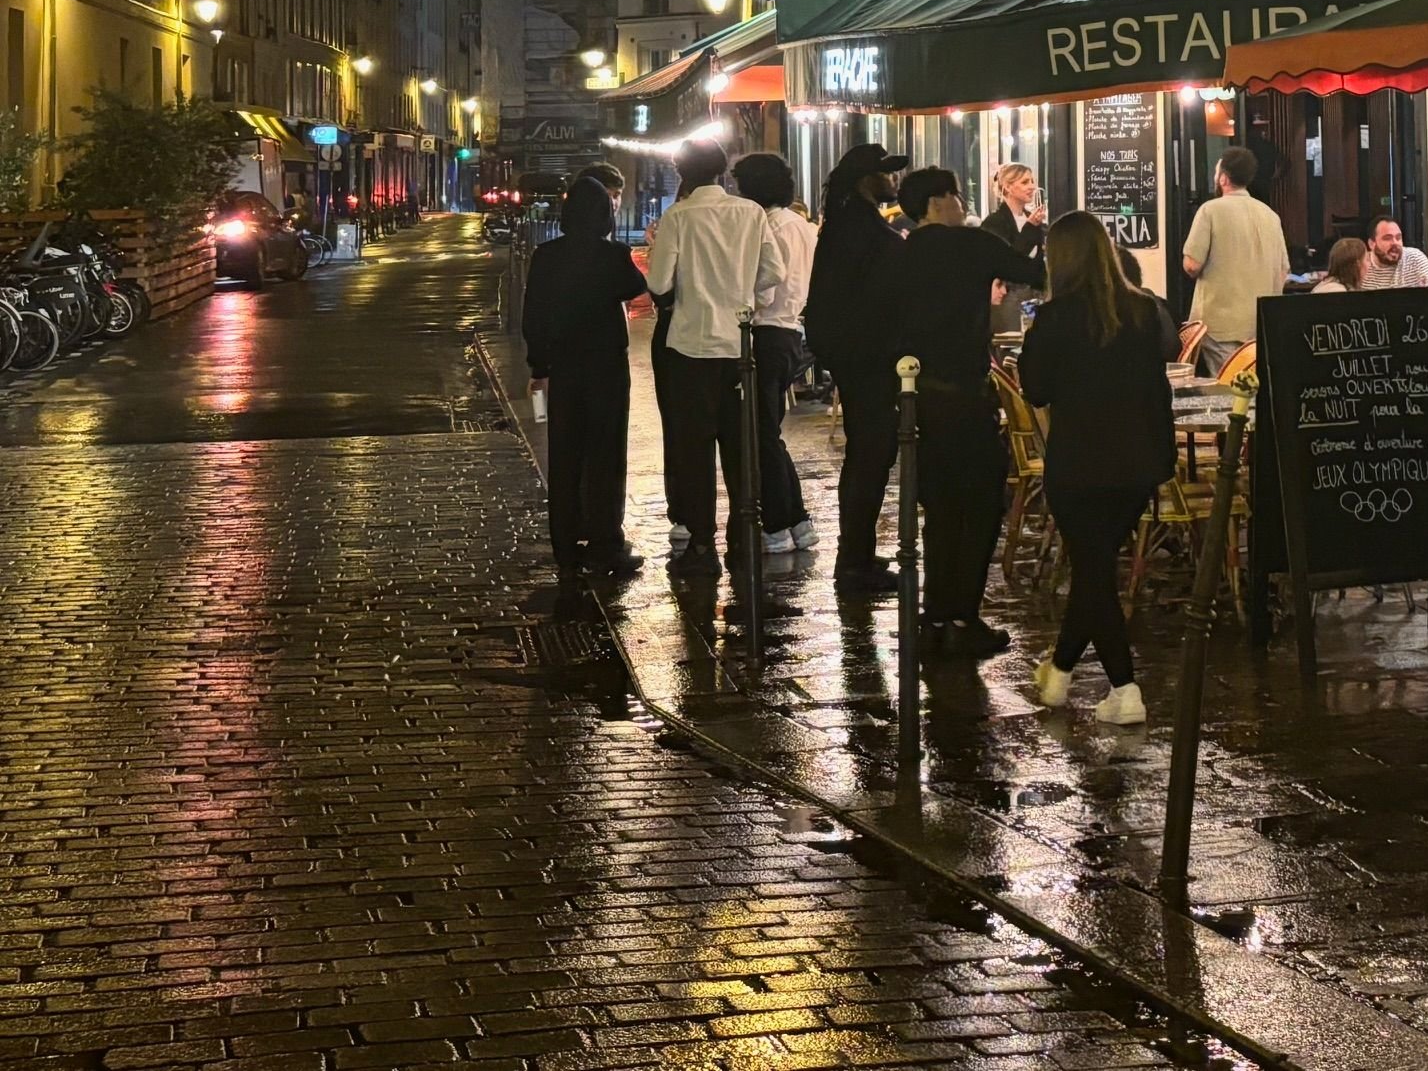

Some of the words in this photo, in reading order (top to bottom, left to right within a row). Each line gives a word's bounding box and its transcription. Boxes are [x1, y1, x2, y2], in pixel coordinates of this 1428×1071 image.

[1046, 3, 1360, 76] RESTAUR
[1100, 150, 1116, 161] NOS
[1097, 214, 1152, 244] ERIA
[1304, 315, 1391, 352] VENDREDI
[1401, 314, 1428, 344] 26
[1325, 397, 1362, 419] NUIT
[1313, 464, 1348, 490] JEUX
